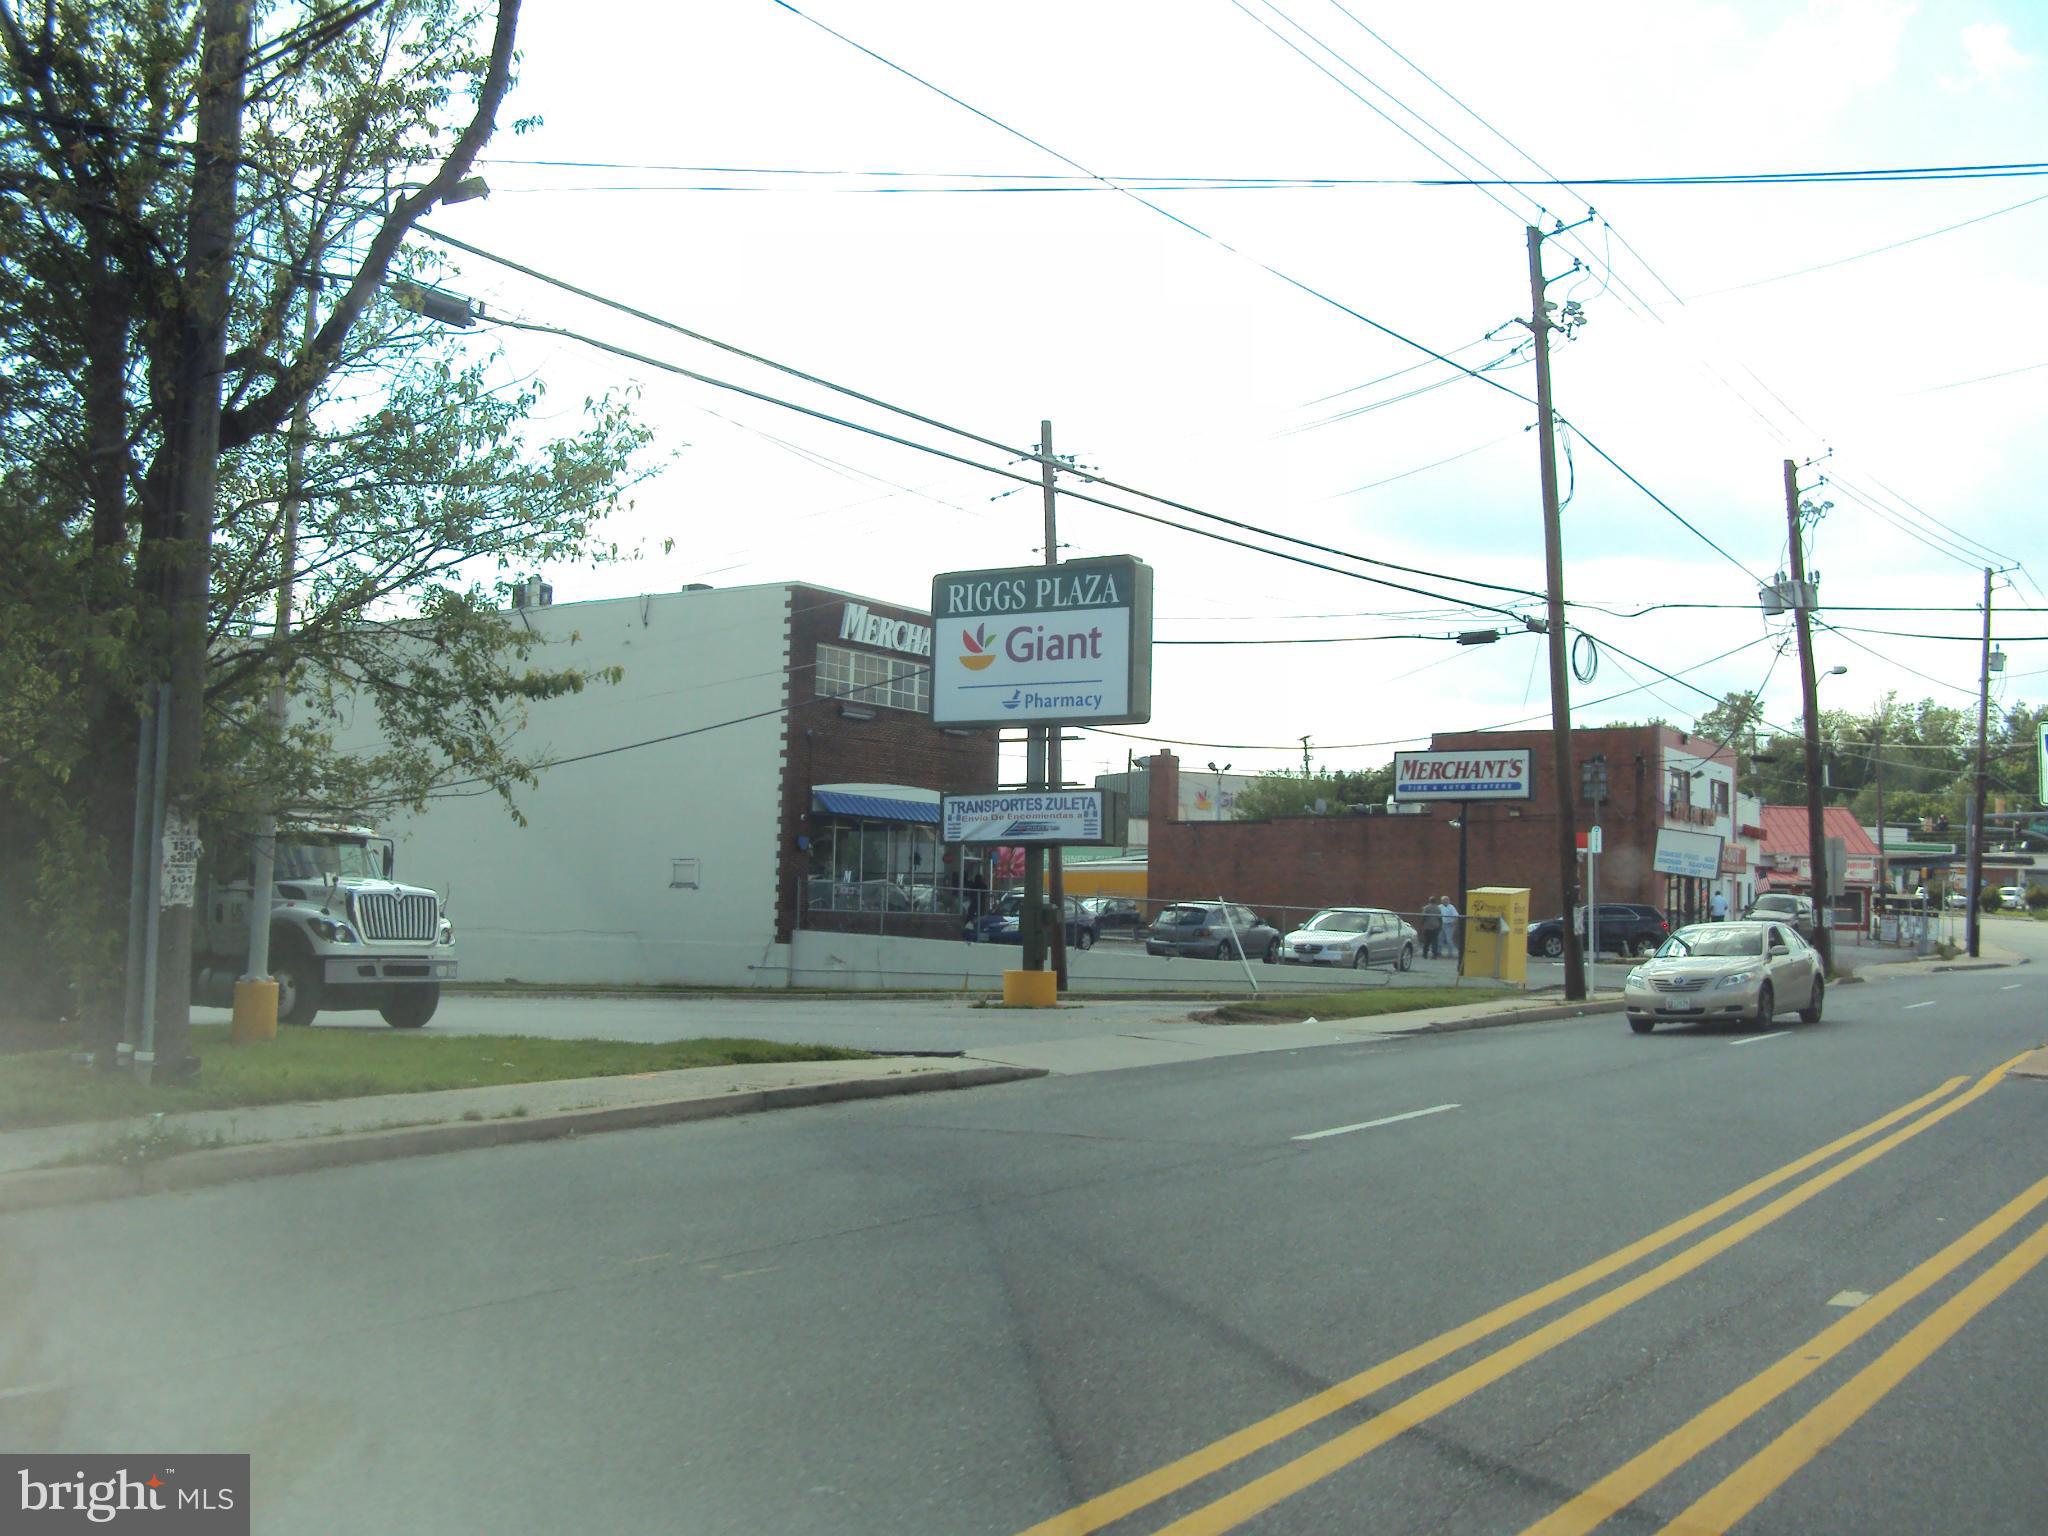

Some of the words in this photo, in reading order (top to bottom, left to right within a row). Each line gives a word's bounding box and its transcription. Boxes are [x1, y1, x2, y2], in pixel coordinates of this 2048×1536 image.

[947, 579, 1026, 613] RIGGS
[1035, 573, 1120, 608] PLAZA
[1005, 625, 1103, 663] Giant
[1025, 693, 1102, 710] Pharmacy
[1400, 758, 1523, 780] MERCHANT'S
[948, 798, 1043, 814] TRANSPORTES
[1045, 796, 1096, 811] ZULETA
[1007, 812, 1074, 820] Encomiendas
